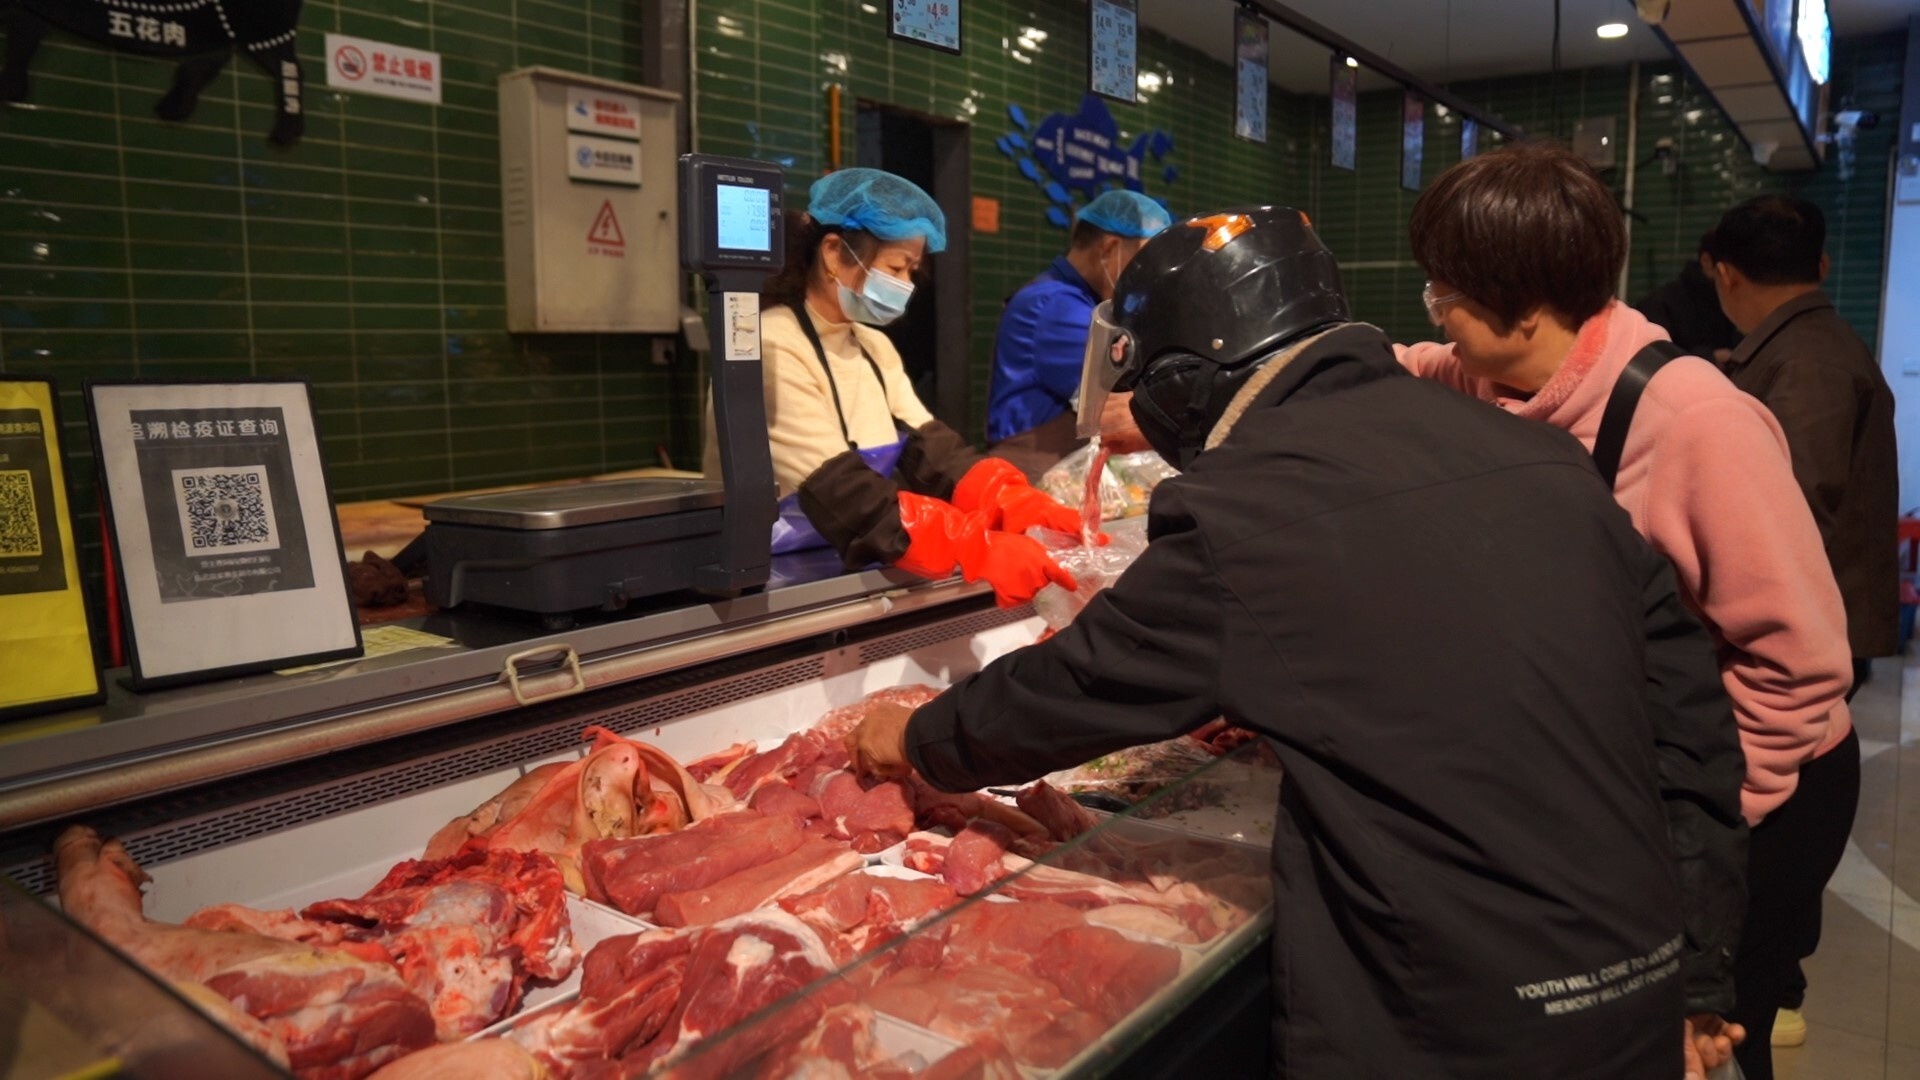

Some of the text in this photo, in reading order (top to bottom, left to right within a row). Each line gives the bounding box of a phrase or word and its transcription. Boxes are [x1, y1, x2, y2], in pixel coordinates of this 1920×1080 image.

[108, 10, 186, 47] 五花肉
[372, 51, 433, 82] 禁止吸烟
[1515, 979, 1566, 1000] YOUTH
[1564, 972, 1600, 991] WILL
[1600, 960, 1630, 982] COME
[1630, 956, 1648, 972] TO
[1544, 993, 1599, 1016] MEMORY
[1599, 984, 1622, 1002] WILL
[1622, 974, 1646, 994] LAST
